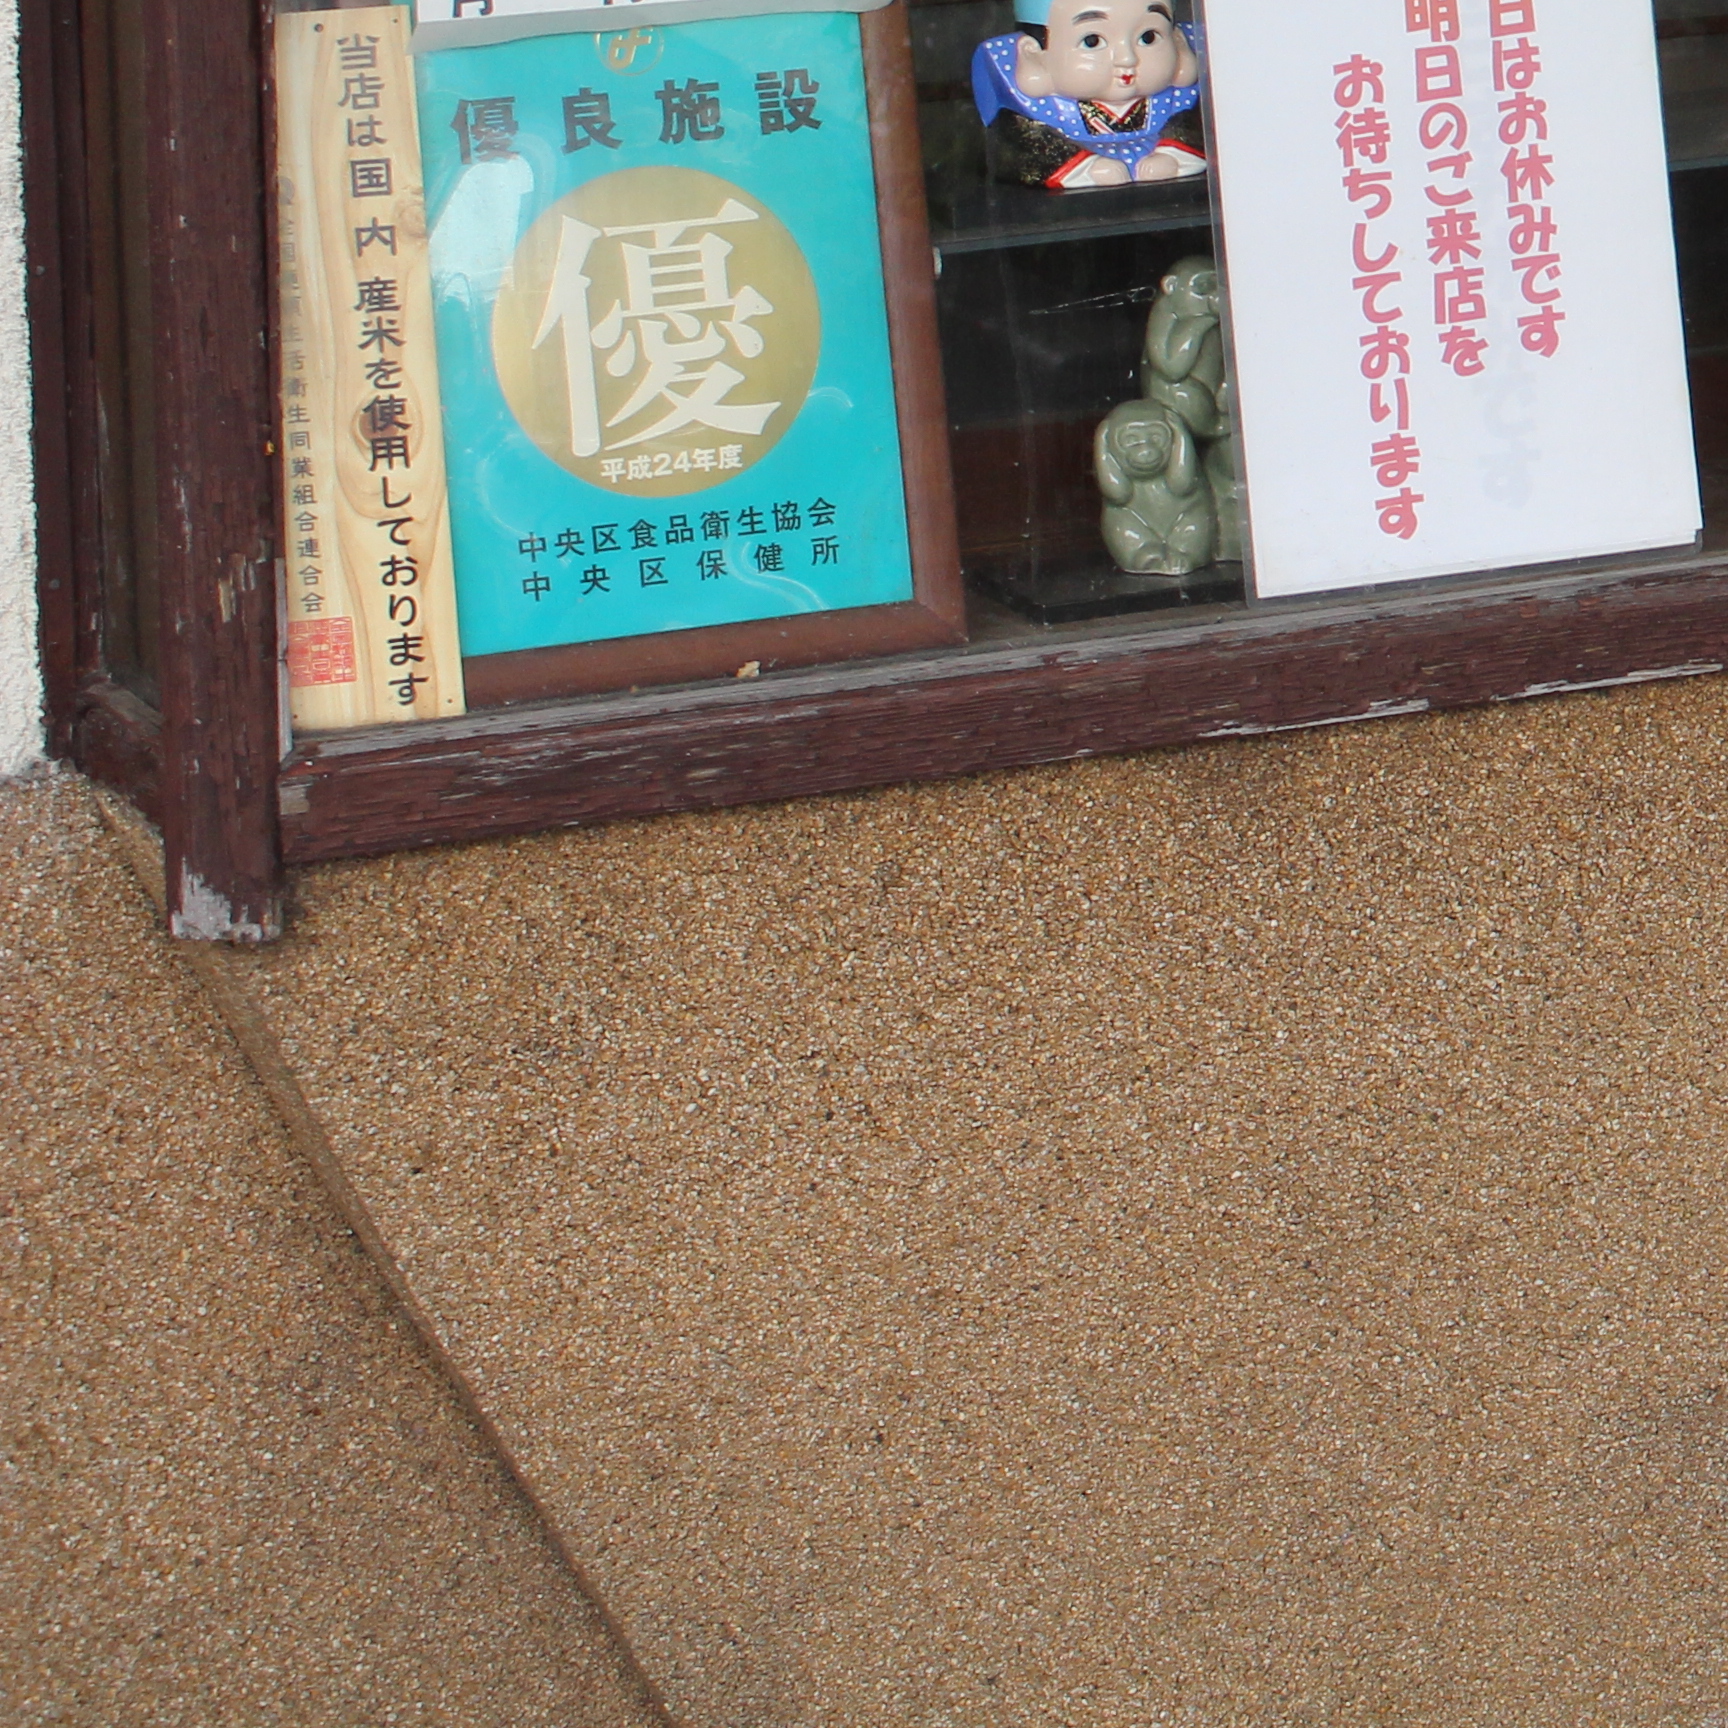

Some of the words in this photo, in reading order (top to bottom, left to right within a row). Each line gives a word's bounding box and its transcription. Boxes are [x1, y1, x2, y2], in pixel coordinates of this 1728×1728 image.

[450, 67, 822, 164] 優良施設
[531, 197, 783, 460] 優
[1332, 53, 1425, 540] お待ちしております
[337, 32, 430, 707] 当店は国内産米を使用しております
[600, 444, 745, 484] 平成24年度
[518, 496, 839, 563] 中央区食品衛生協会
[521, 535, 840, 604] 中央区保健所
